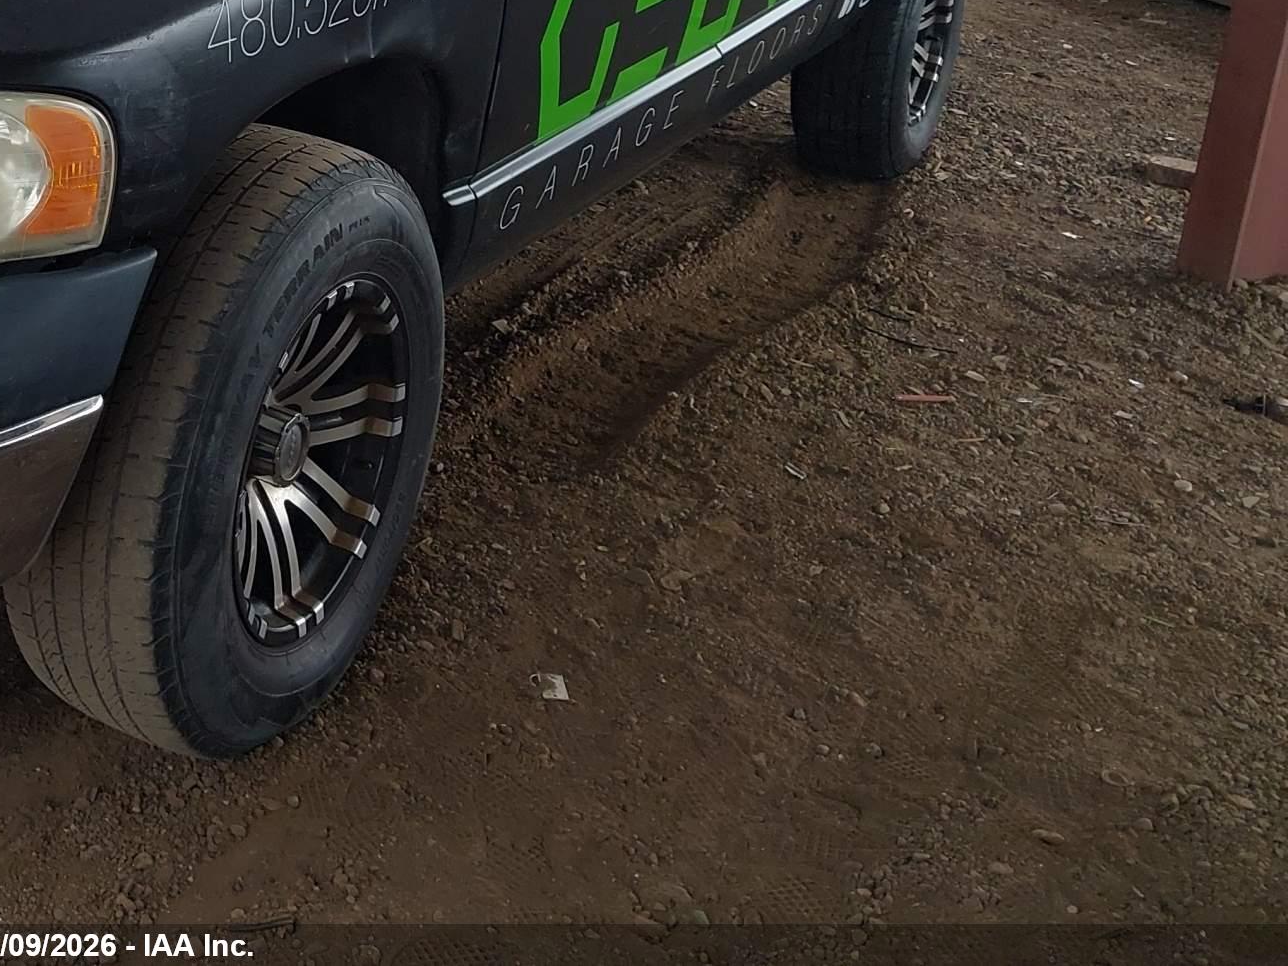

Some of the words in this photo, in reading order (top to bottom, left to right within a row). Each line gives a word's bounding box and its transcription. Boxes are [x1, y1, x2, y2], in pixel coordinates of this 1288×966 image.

[499, 89, 685, 231] GARAGE
[704, 3, 824, 104] FLOORS
[262, 222, 344, 339] TERRAIN
